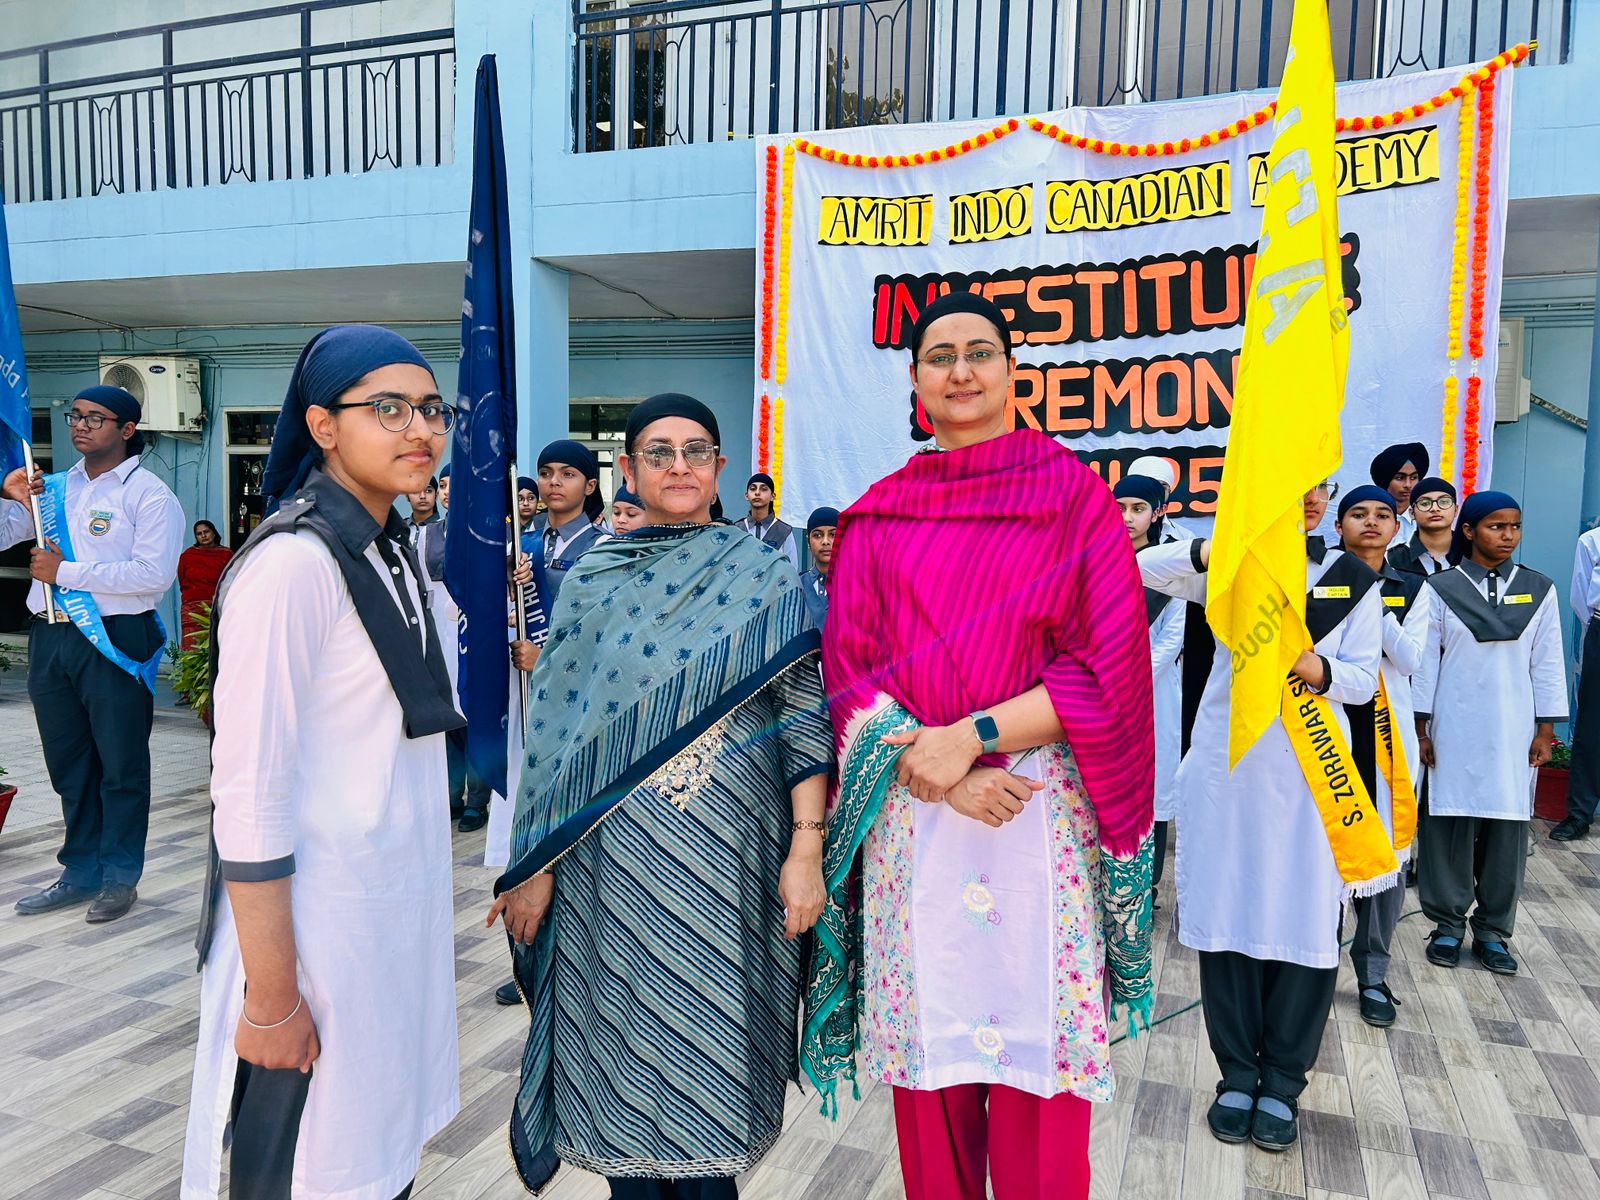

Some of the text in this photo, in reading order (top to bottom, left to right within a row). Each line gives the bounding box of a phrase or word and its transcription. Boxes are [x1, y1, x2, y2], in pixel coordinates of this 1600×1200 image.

[829, 200, 931, 239] AMRIT
[953, 192, 1026, 237] INDO
[1049, 168, 1225, 226] CANADIAN
[64, 597, 93, 628] AJIT
[526, 608, 546, 624] JI
[1299, 698, 1355, 803] ZORAWAR
[1342, 803, 1364, 827] S.
